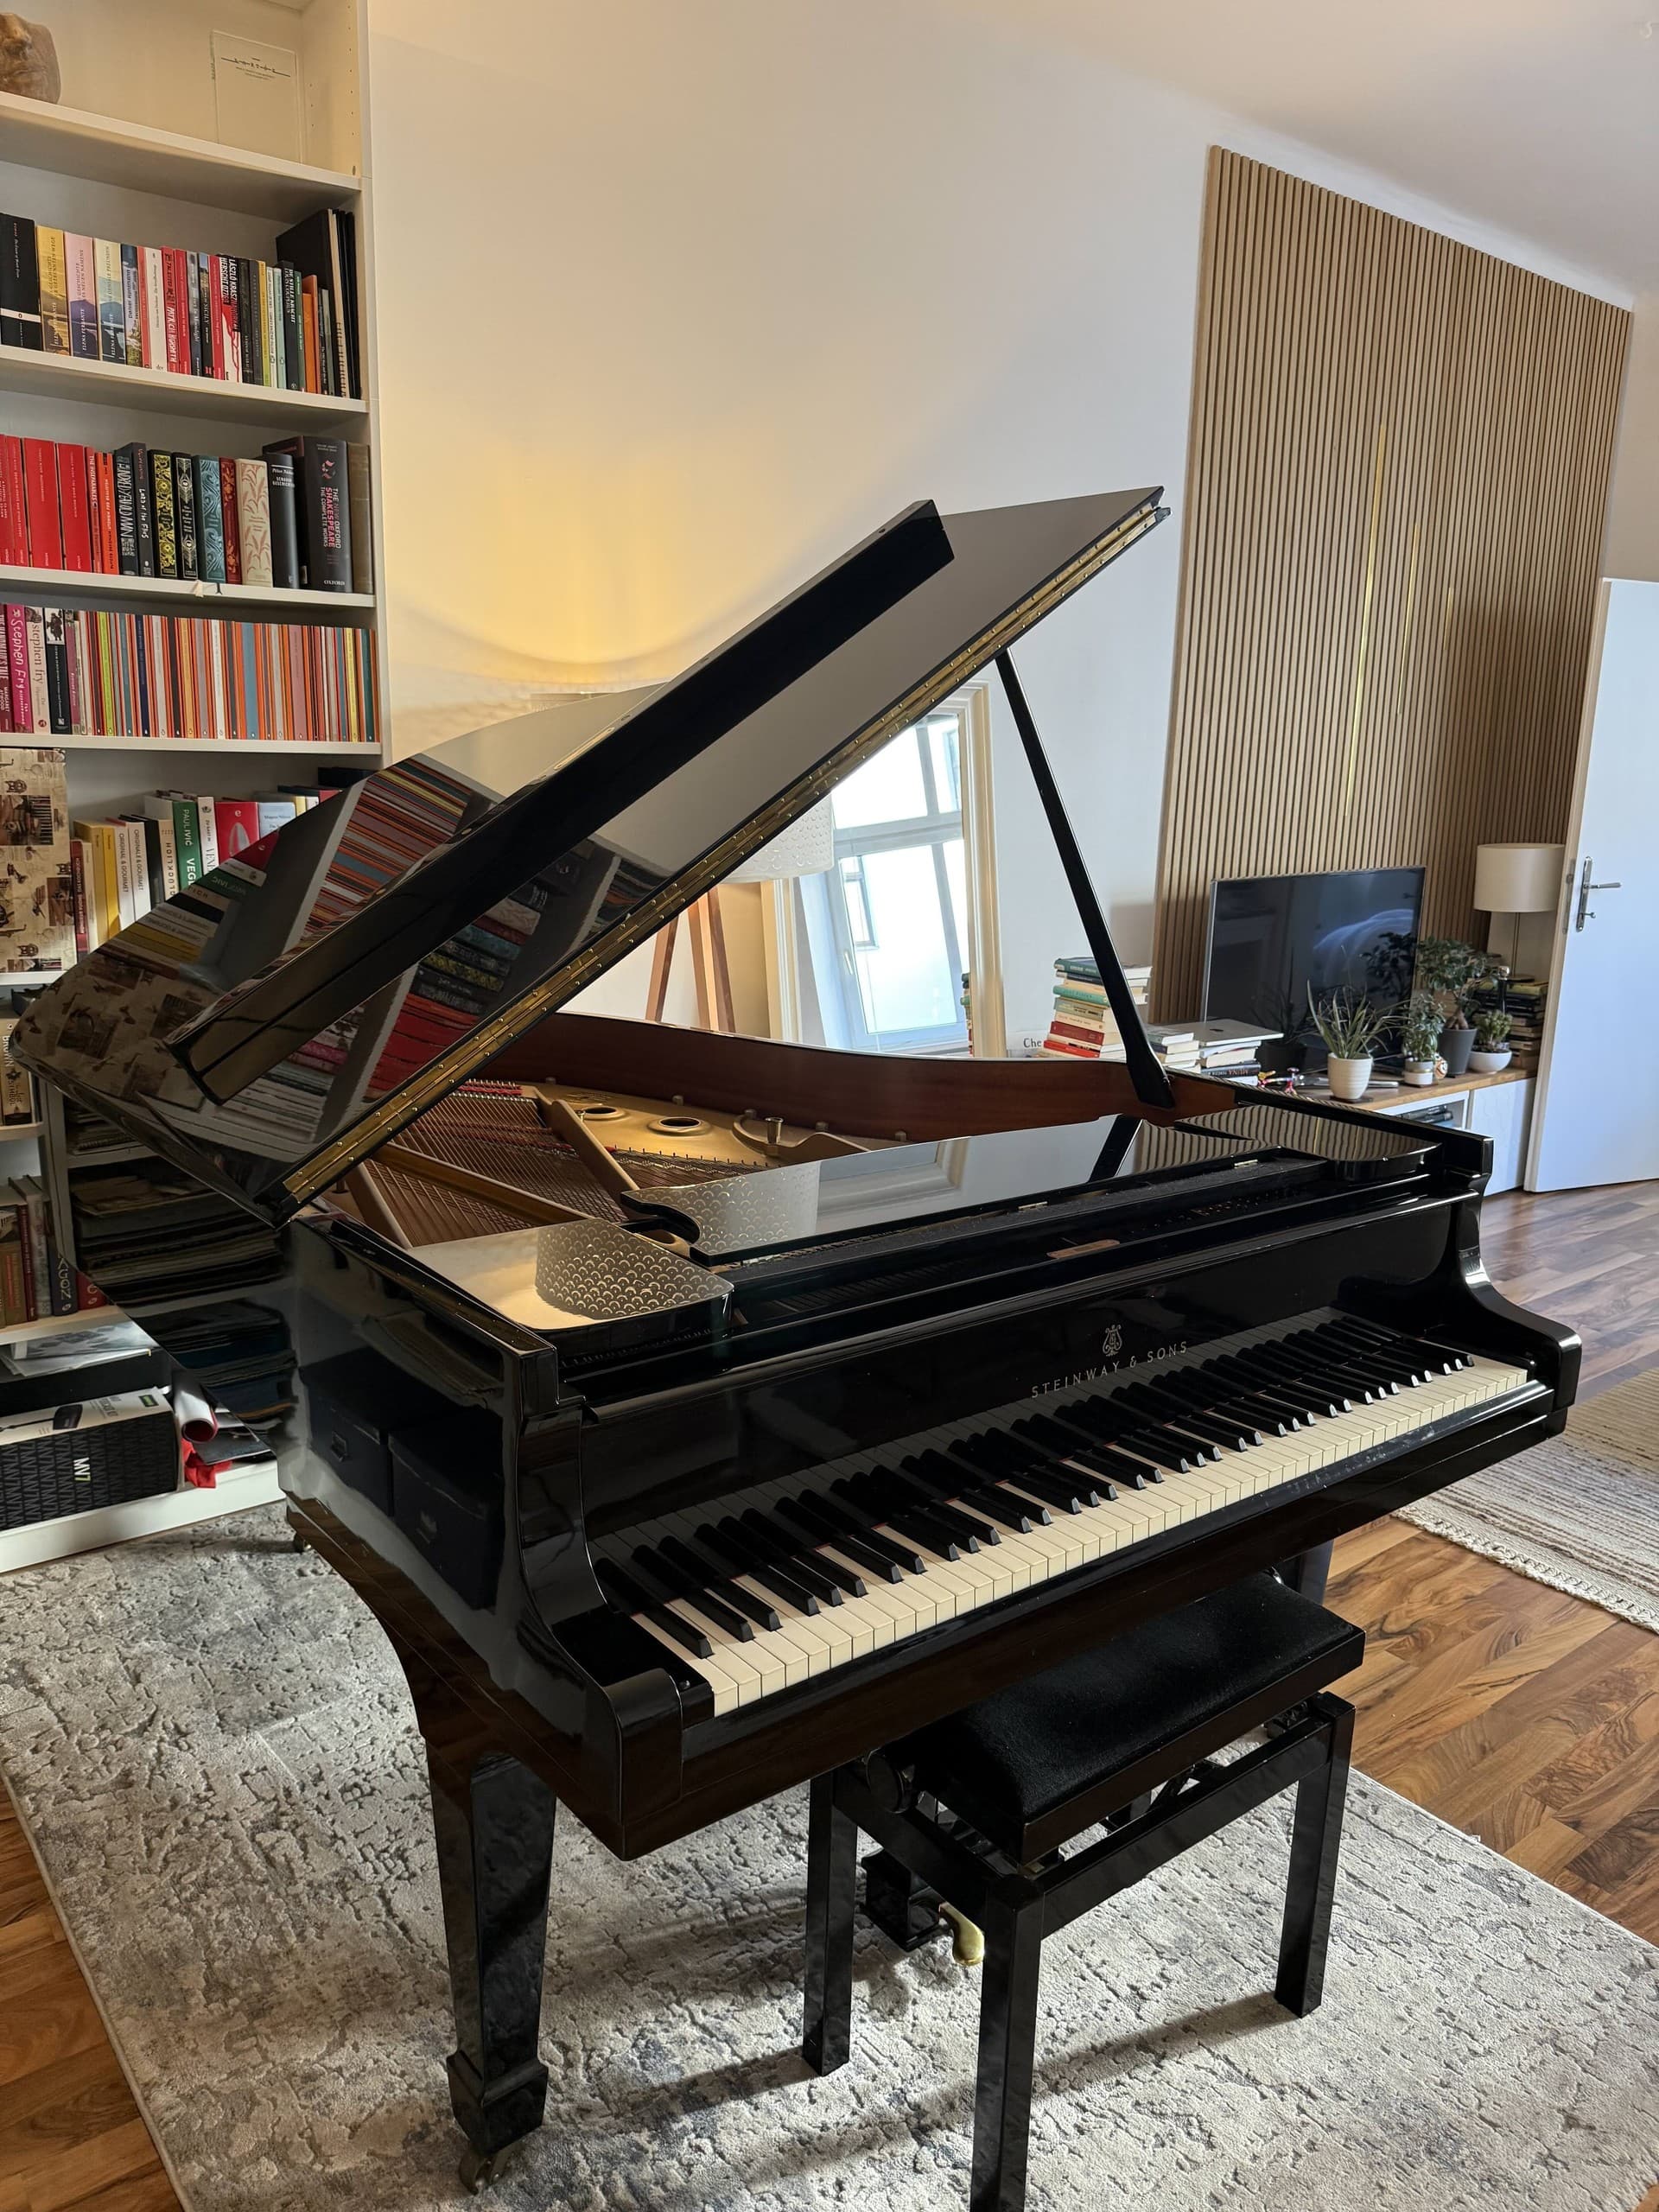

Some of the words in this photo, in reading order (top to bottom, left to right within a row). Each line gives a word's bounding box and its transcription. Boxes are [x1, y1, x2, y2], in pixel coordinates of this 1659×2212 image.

[220, 257, 229, 285] HERSCHT
[229, 259, 238, 281] LÁSZLÓ
[168, 334, 177, 362] HIGHSMITH
[326, 487, 335, 548] SHAKESPEARE
[10, 619, 24, 664] Stephen
[29, 624, 44, 665] stephen
[15, 670, 26, 688] Fry
[34, 669, 45, 684] fry
[184, 830, 194, 846] IVIĆ
[1031, 1360, 1120, 1399] STEINWAY
[1129, 1355, 1137, 1368] &
[1147, 1340, 1188, 1363] SONS
[73, 1456, 92, 1483] MV7
